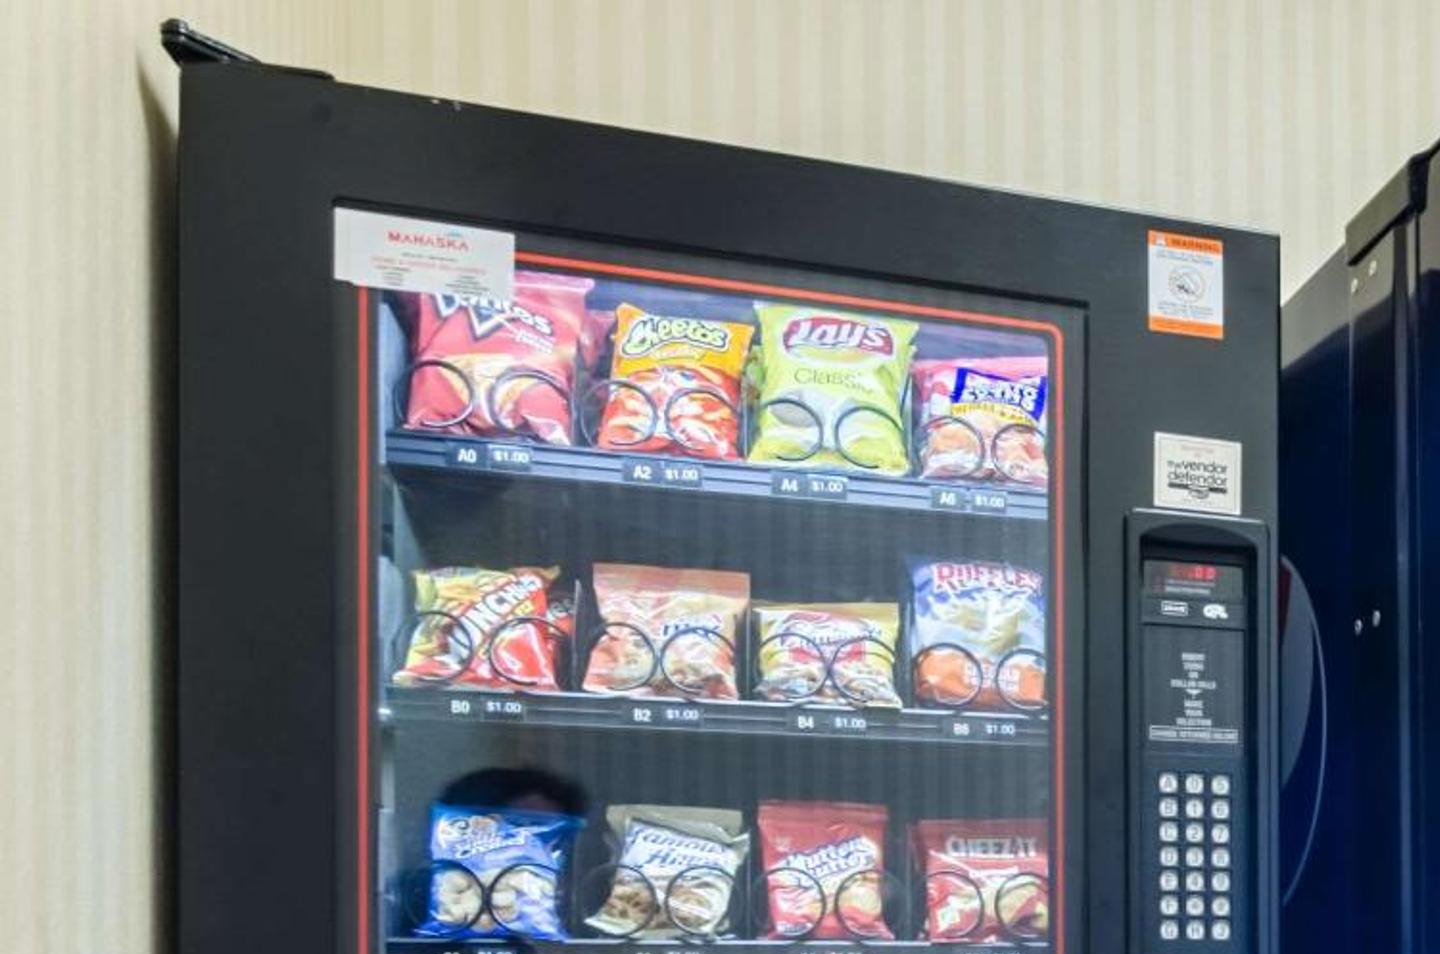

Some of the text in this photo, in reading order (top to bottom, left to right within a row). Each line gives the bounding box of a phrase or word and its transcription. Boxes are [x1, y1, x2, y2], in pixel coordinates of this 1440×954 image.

[621, 315, 729, 356] Cheetos
[494, 452, 529, 464] $1.00
[665, 469, 698, 481] $1.00
[811, 481, 843, 492] $1.00
[486, 701, 521, 713] $1.00
[666, 709, 699, 720] $1.00
[835, 718, 866, 729] $1.00
[986, 724, 1015, 735] $1.00
